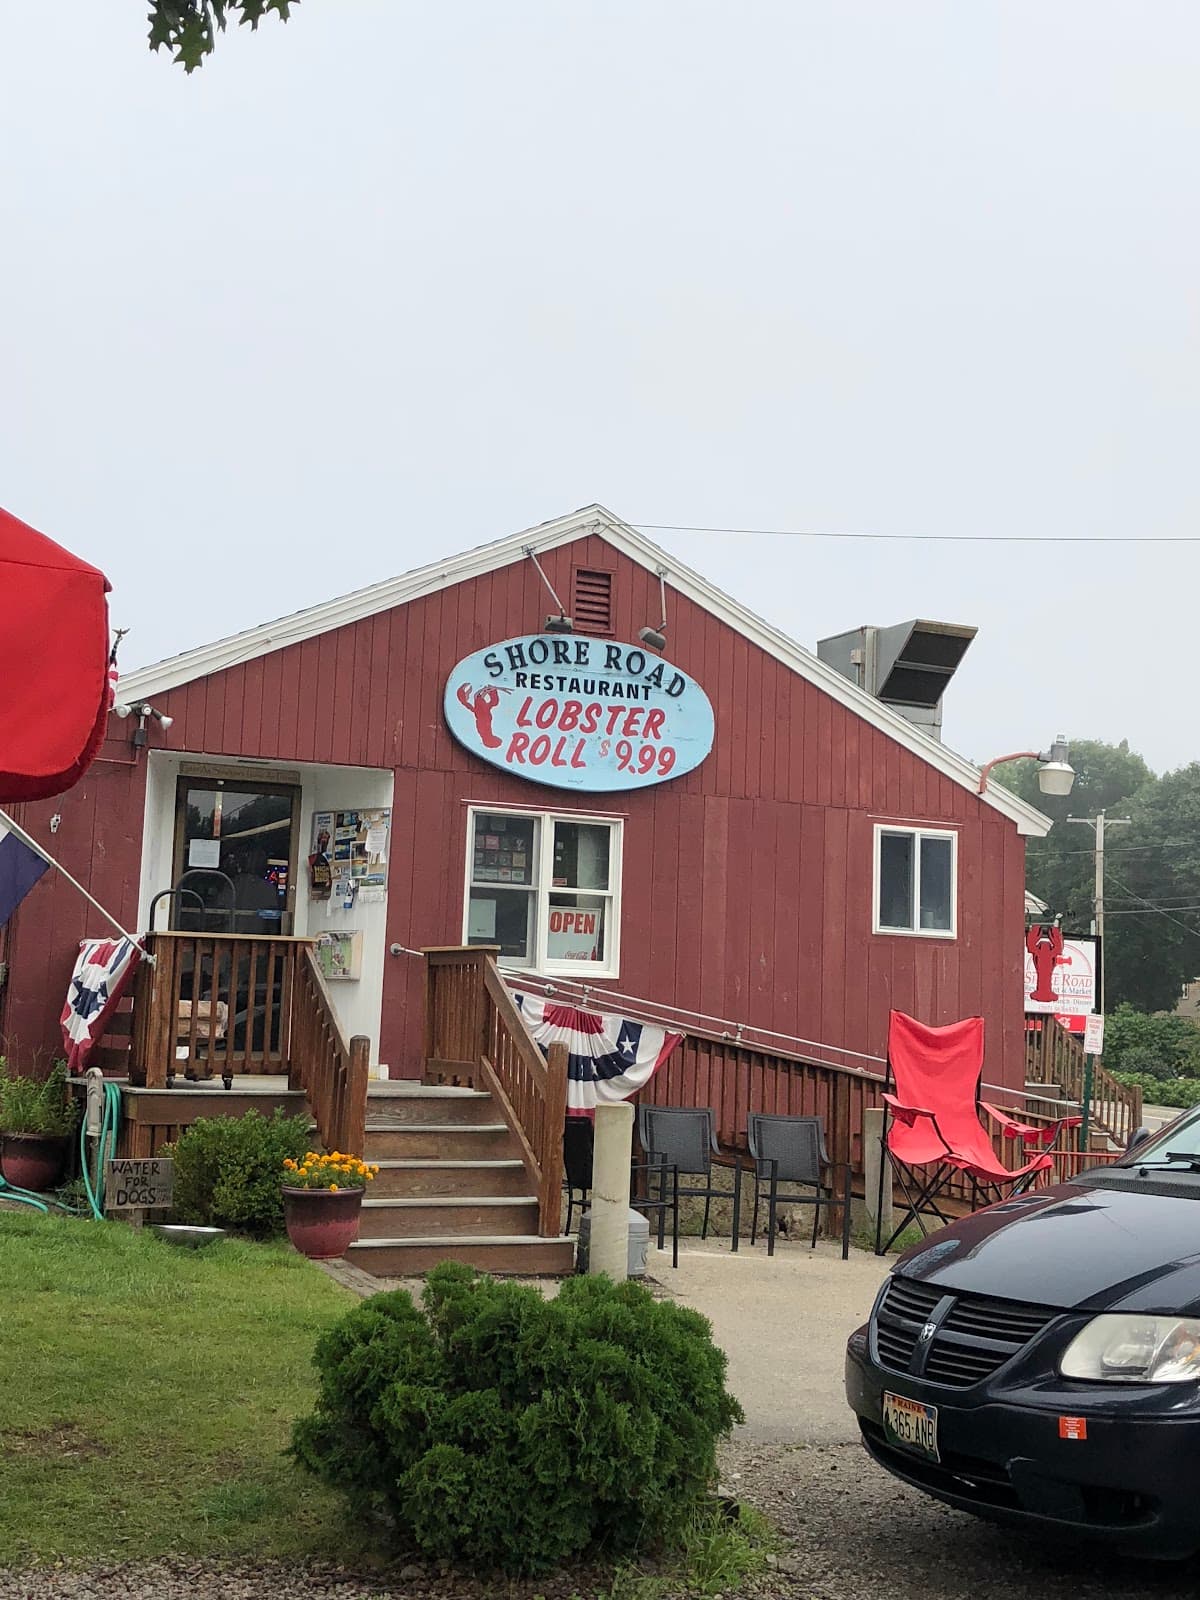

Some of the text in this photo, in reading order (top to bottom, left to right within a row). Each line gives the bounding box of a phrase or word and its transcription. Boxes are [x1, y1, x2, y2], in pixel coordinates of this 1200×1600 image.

[484, 639, 686, 698] SHORE ROAD
[516, 672, 652, 700] RESTAURANT
[516, 696, 665, 739] LOBSTER
[506, 732, 586, 768] ROLL
[550, 911, 595, 934] OPEN
[1062, 974, 1092, 987] ROAD
[1069, 987, 1092, 995] Market
[111, 1161, 160, 1176] WATER
[125, 1177, 149, 1187] FOR
[116, 1187, 156, 1206] DOGS
